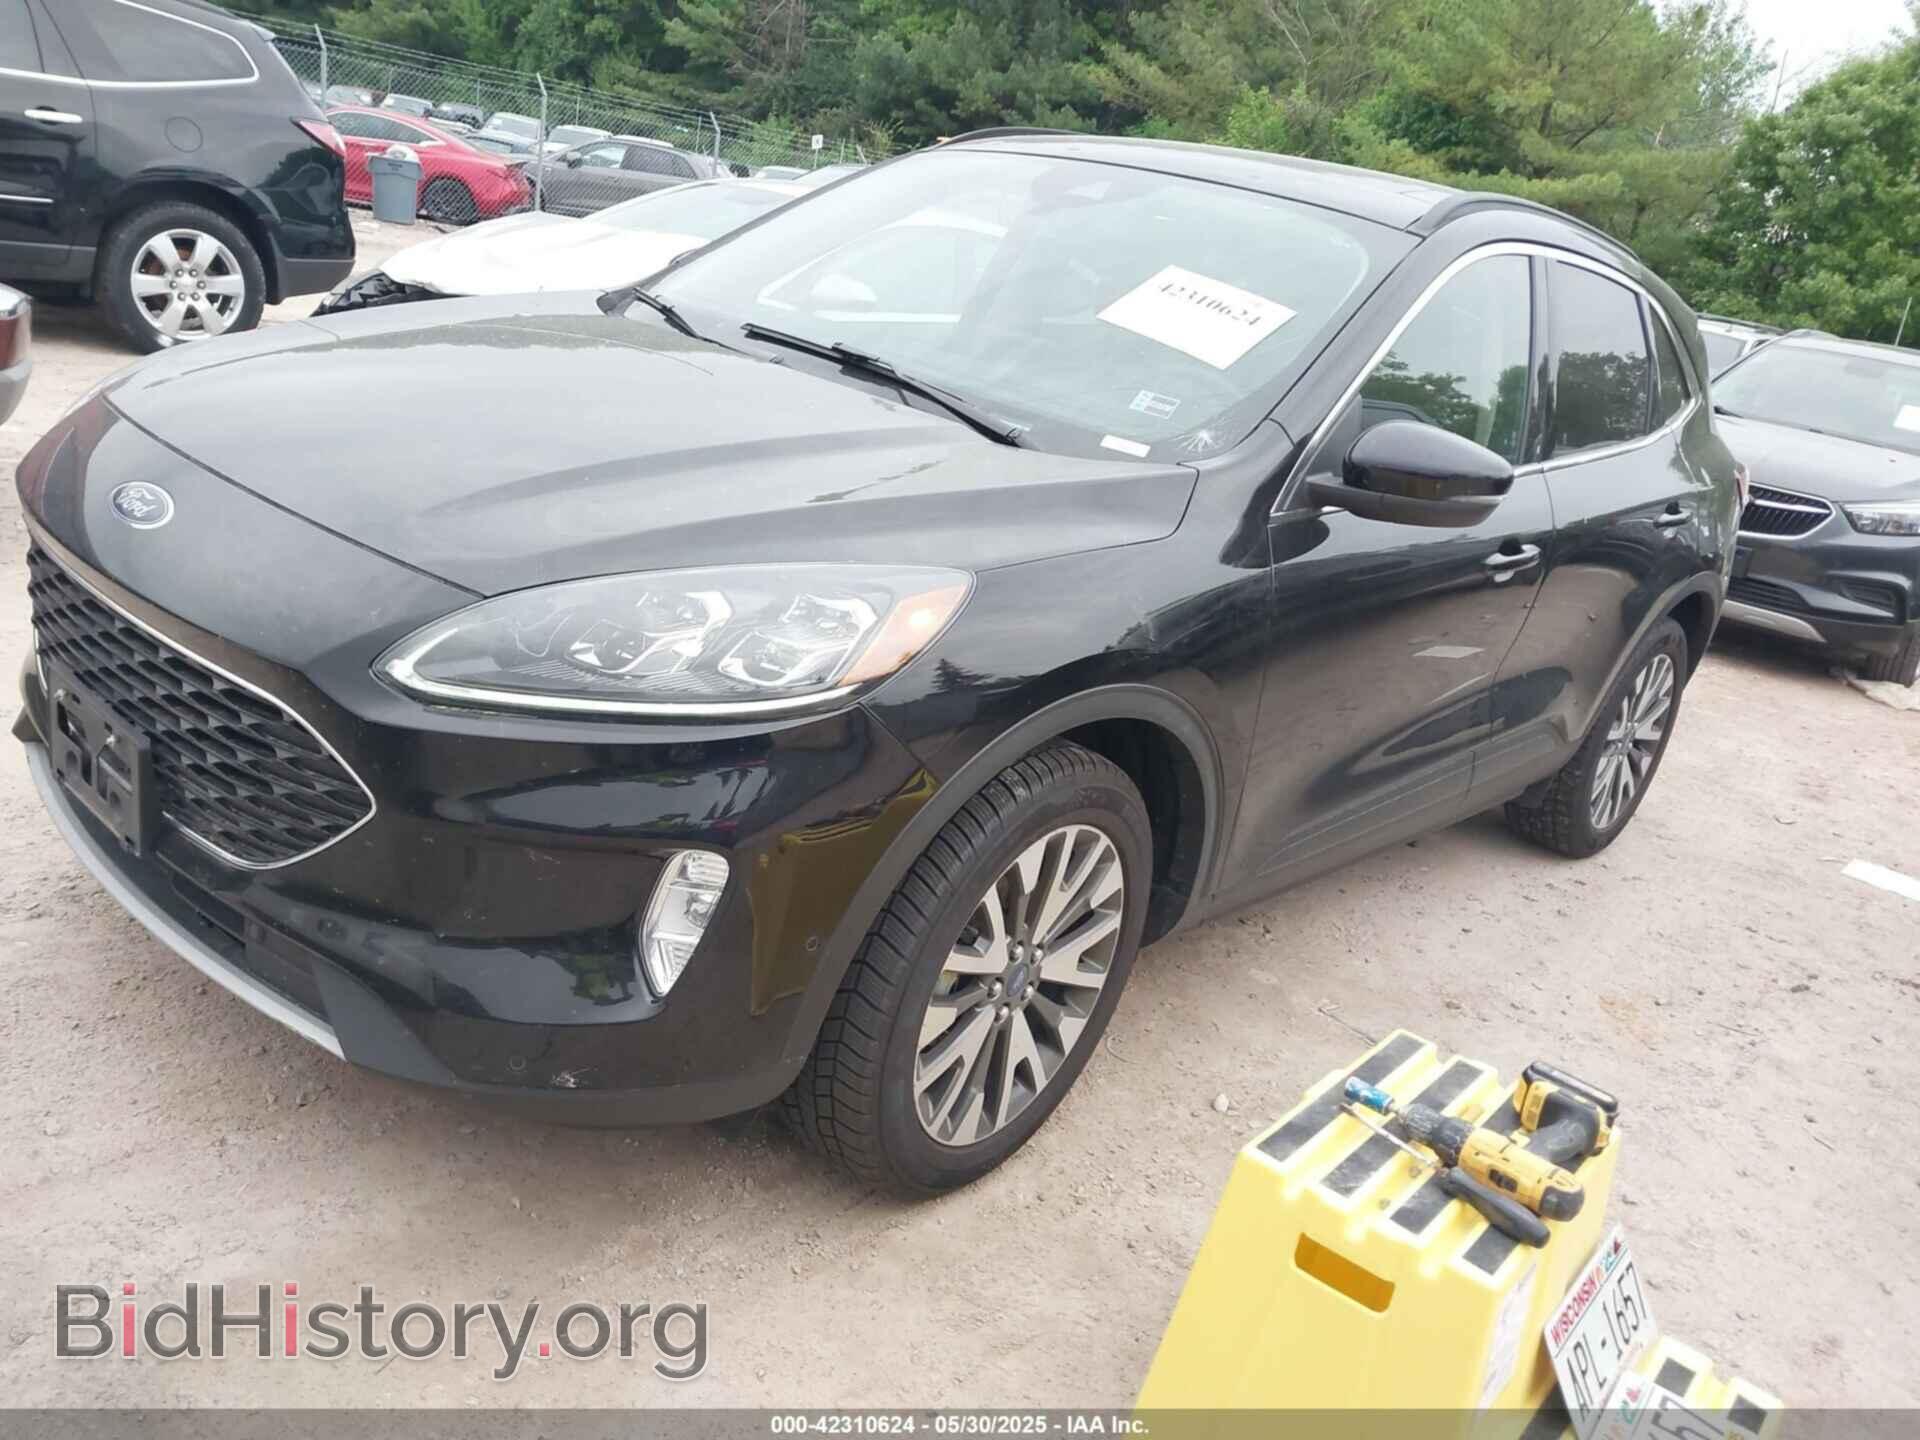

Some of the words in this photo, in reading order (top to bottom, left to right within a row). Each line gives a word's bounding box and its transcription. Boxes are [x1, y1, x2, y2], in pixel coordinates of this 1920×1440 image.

[1160, 282, 1261, 326] 42310624
[115, 487, 157, 518] Ford
[1550, 1267, 1604, 1346] WISCONSIN
